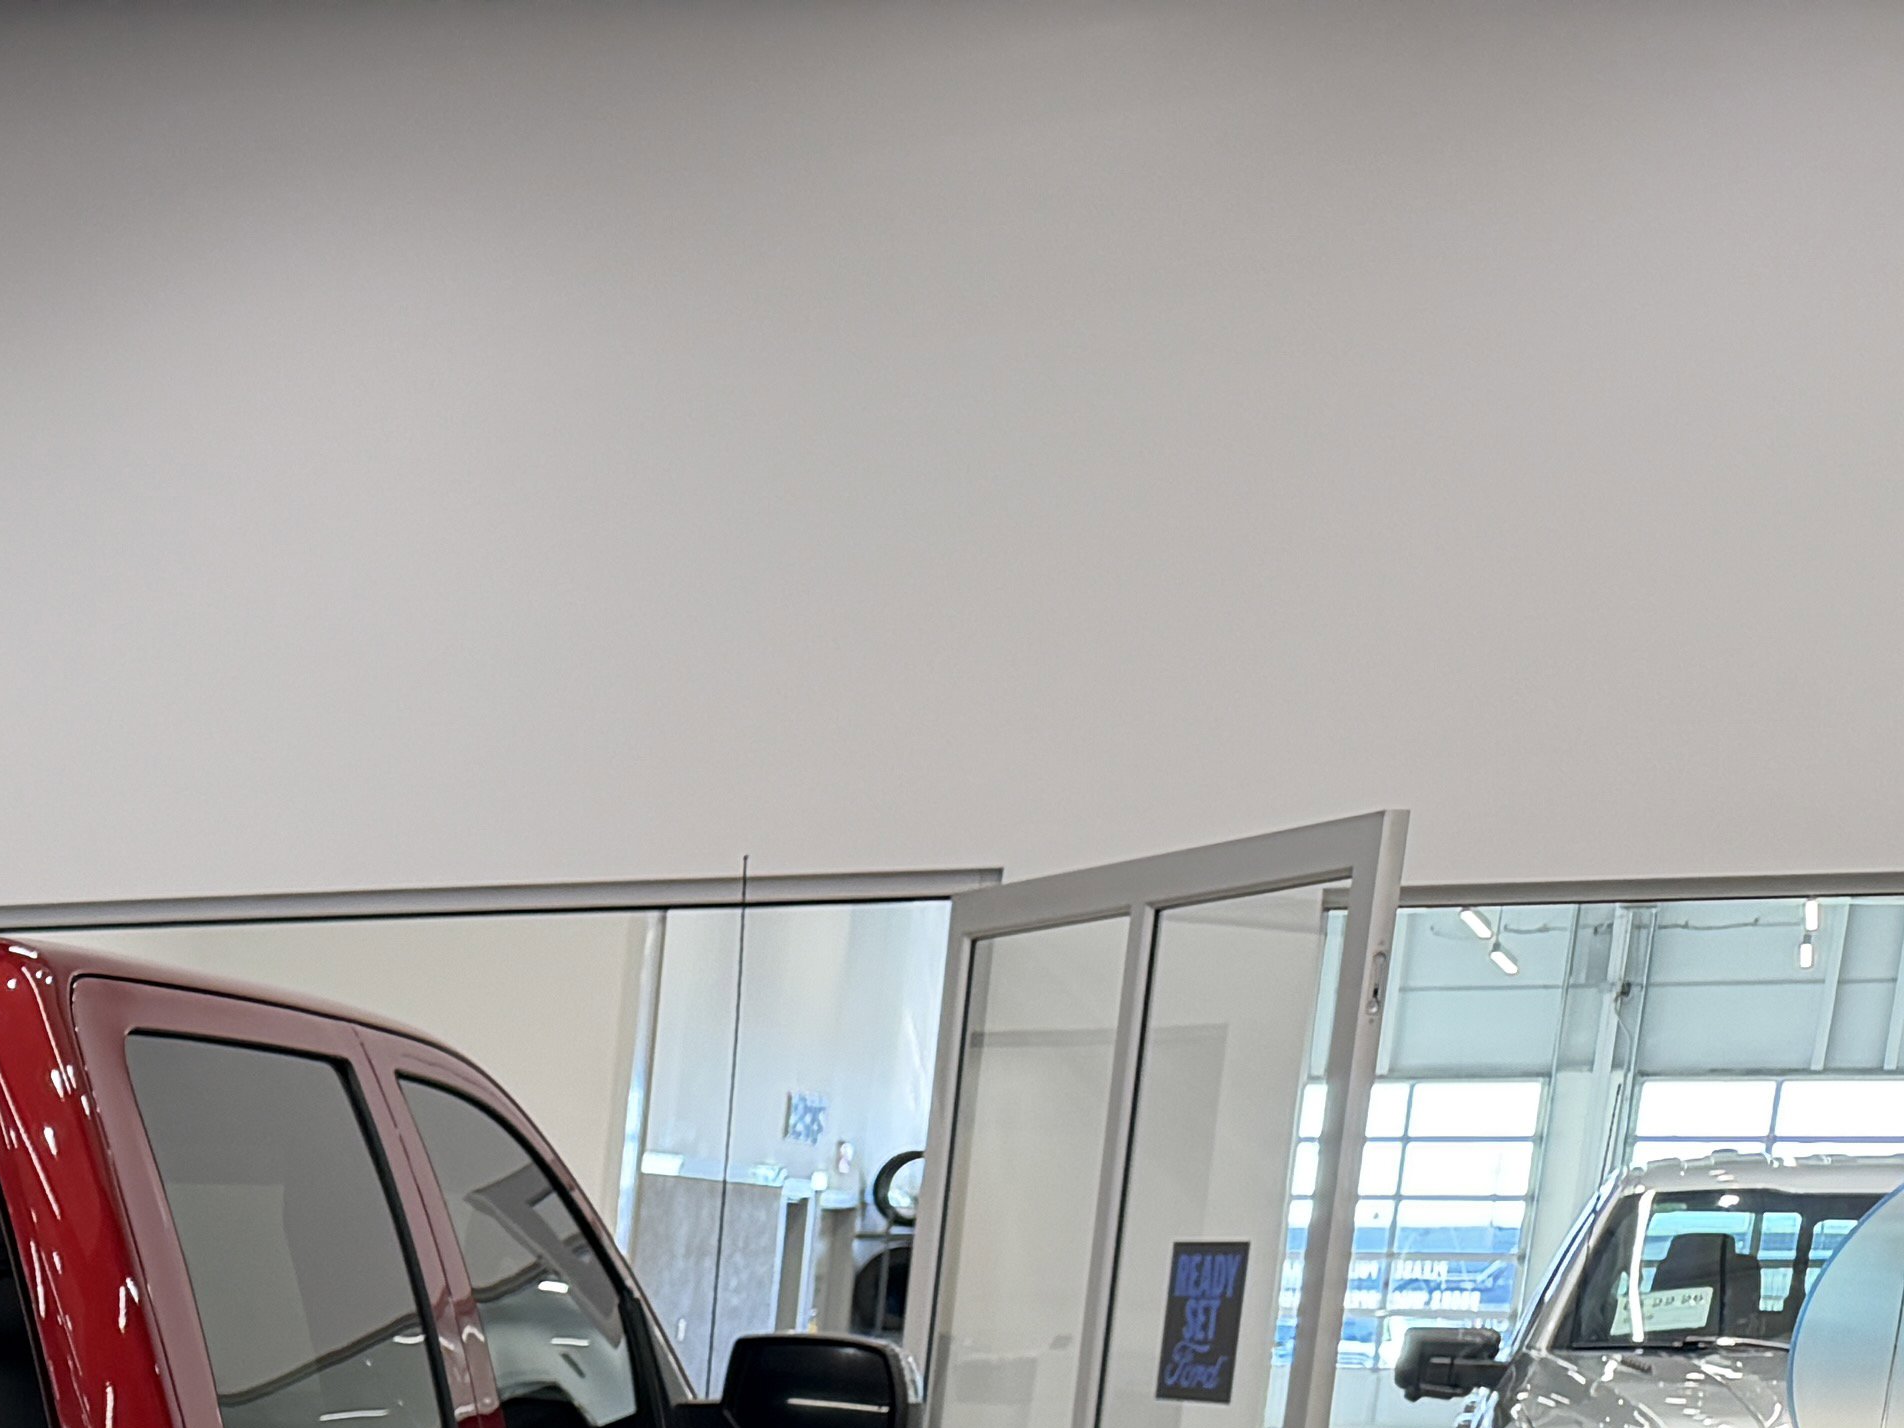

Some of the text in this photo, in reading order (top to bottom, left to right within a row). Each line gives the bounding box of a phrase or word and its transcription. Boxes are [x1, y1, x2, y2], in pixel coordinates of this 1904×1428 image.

[1173, 1253, 1242, 1298] READY
[1182, 1298, 1222, 1341] SET
[1163, 1340, 1228, 1389] Ford
